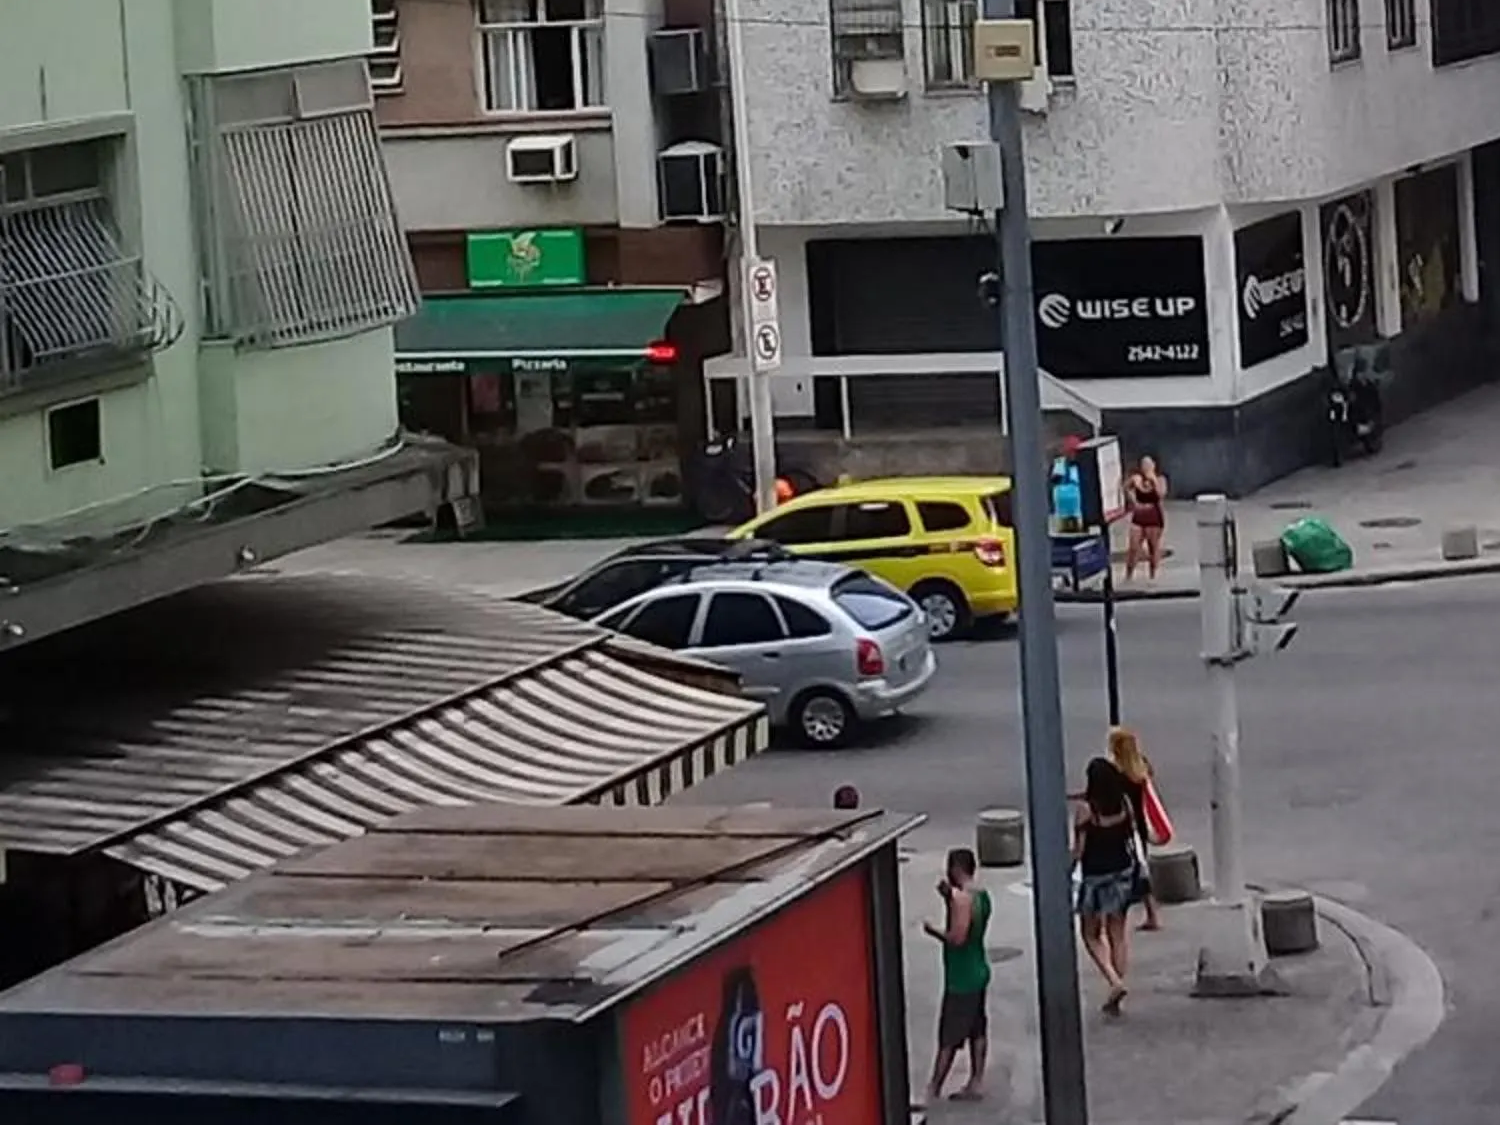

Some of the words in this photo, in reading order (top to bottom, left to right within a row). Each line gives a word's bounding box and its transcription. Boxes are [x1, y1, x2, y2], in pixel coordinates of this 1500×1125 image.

[1076, 298, 1151, 320] WISE
[1154, 296, 1197, 317] UP
[1127, 343, 1200, 362] 2542-4122
